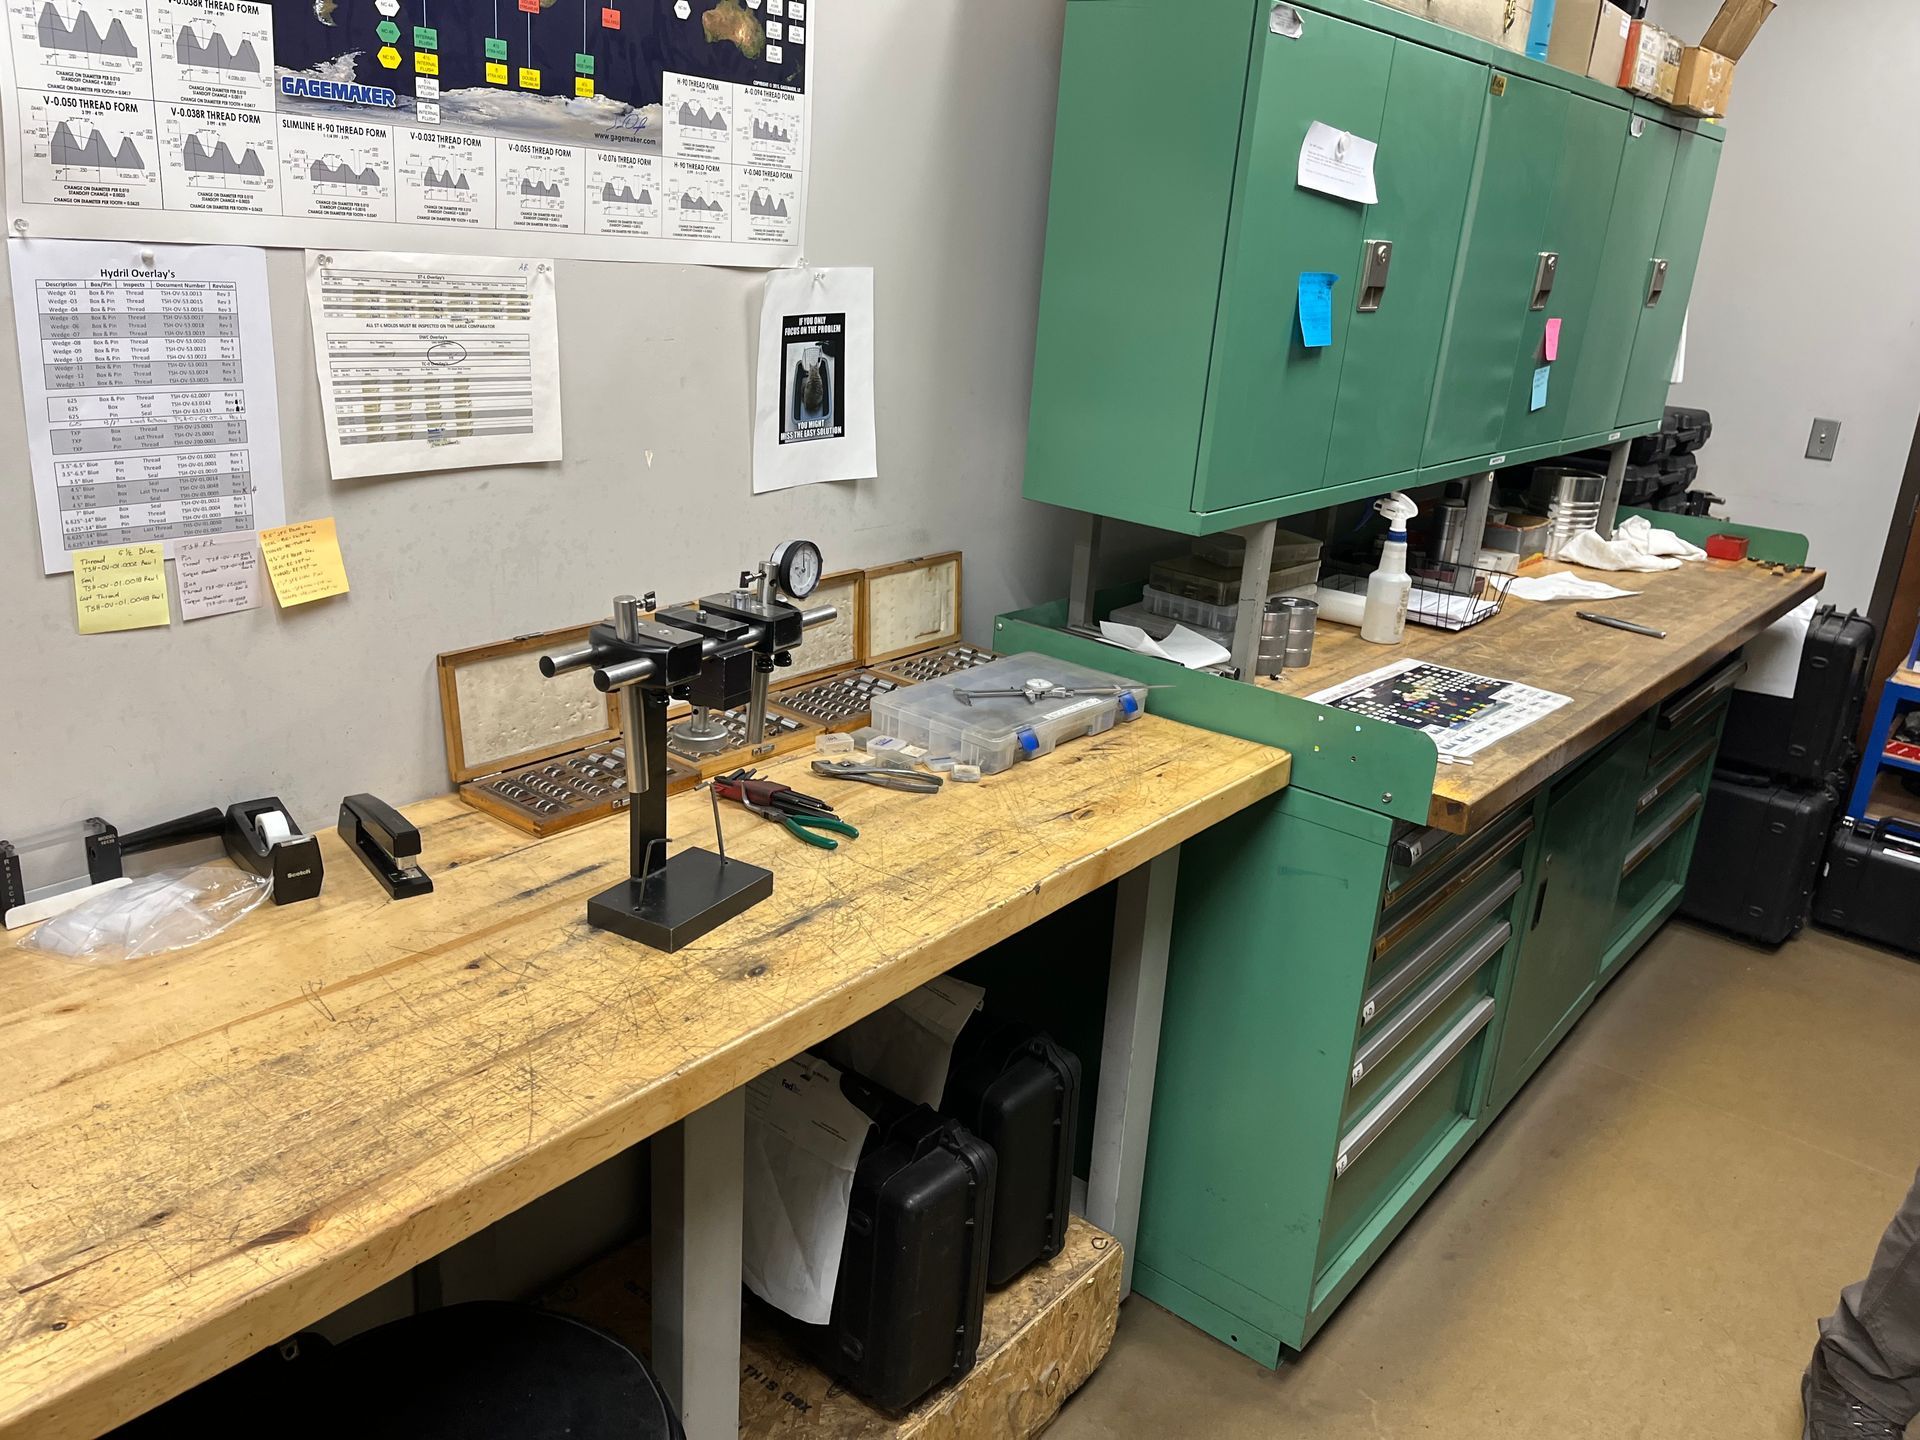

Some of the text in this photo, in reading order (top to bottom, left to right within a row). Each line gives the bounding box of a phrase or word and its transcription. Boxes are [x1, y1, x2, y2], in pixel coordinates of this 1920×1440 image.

[205, 0, 235, 12] THREAD
[237, 4, 260, 15] FORM
[677, 77, 719, 91] H-90 THREAD FORM
[281, 76, 396, 108] GAGEMAKER
[764, 90, 781, 99] THREAD
[782, 92, 795, 101] FORM
[43, 96, 138, 112] V-0.050 THREAD FORM
[171, 107, 260, 124] V-0.038R THREAD FORM
[282, 119, 387, 138] SLIMLINE H-90 THREAD FORM
[410, 132, 482, 147] V-0.032 THREAD FORM
[594, 132, 656, 146] www.gagemaker.com
[508, 143, 572, 157] V-0.055 THREAD FORM
[618, 156, 637, 165] THREAD
[638, 157, 652, 166] FORM
[674, 162, 686, 170] H-90
[686, 163, 704, 171] THREAD
[743, 168, 793, 180] V-0.040 THREAD FORM
[100, 269, 176, 279] Hydril Overlay's
[799, 316, 826, 326] IF YOU ONLY
[785, 324, 841, 336] FOCUS ON THE PROBLEM
[809, 420, 824, 428] MIGHT
[781, 432, 793, 440] MISS
[804, 429, 816, 438] EASY
[817, 426, 842, 436] SOLUTION
[139, 547, 156, 555] Blue
[80, 555, 106, 565] Thread
[287, 868, 311, 879] Scotch
[744, 1364, 812, 1413] THIS BOX
